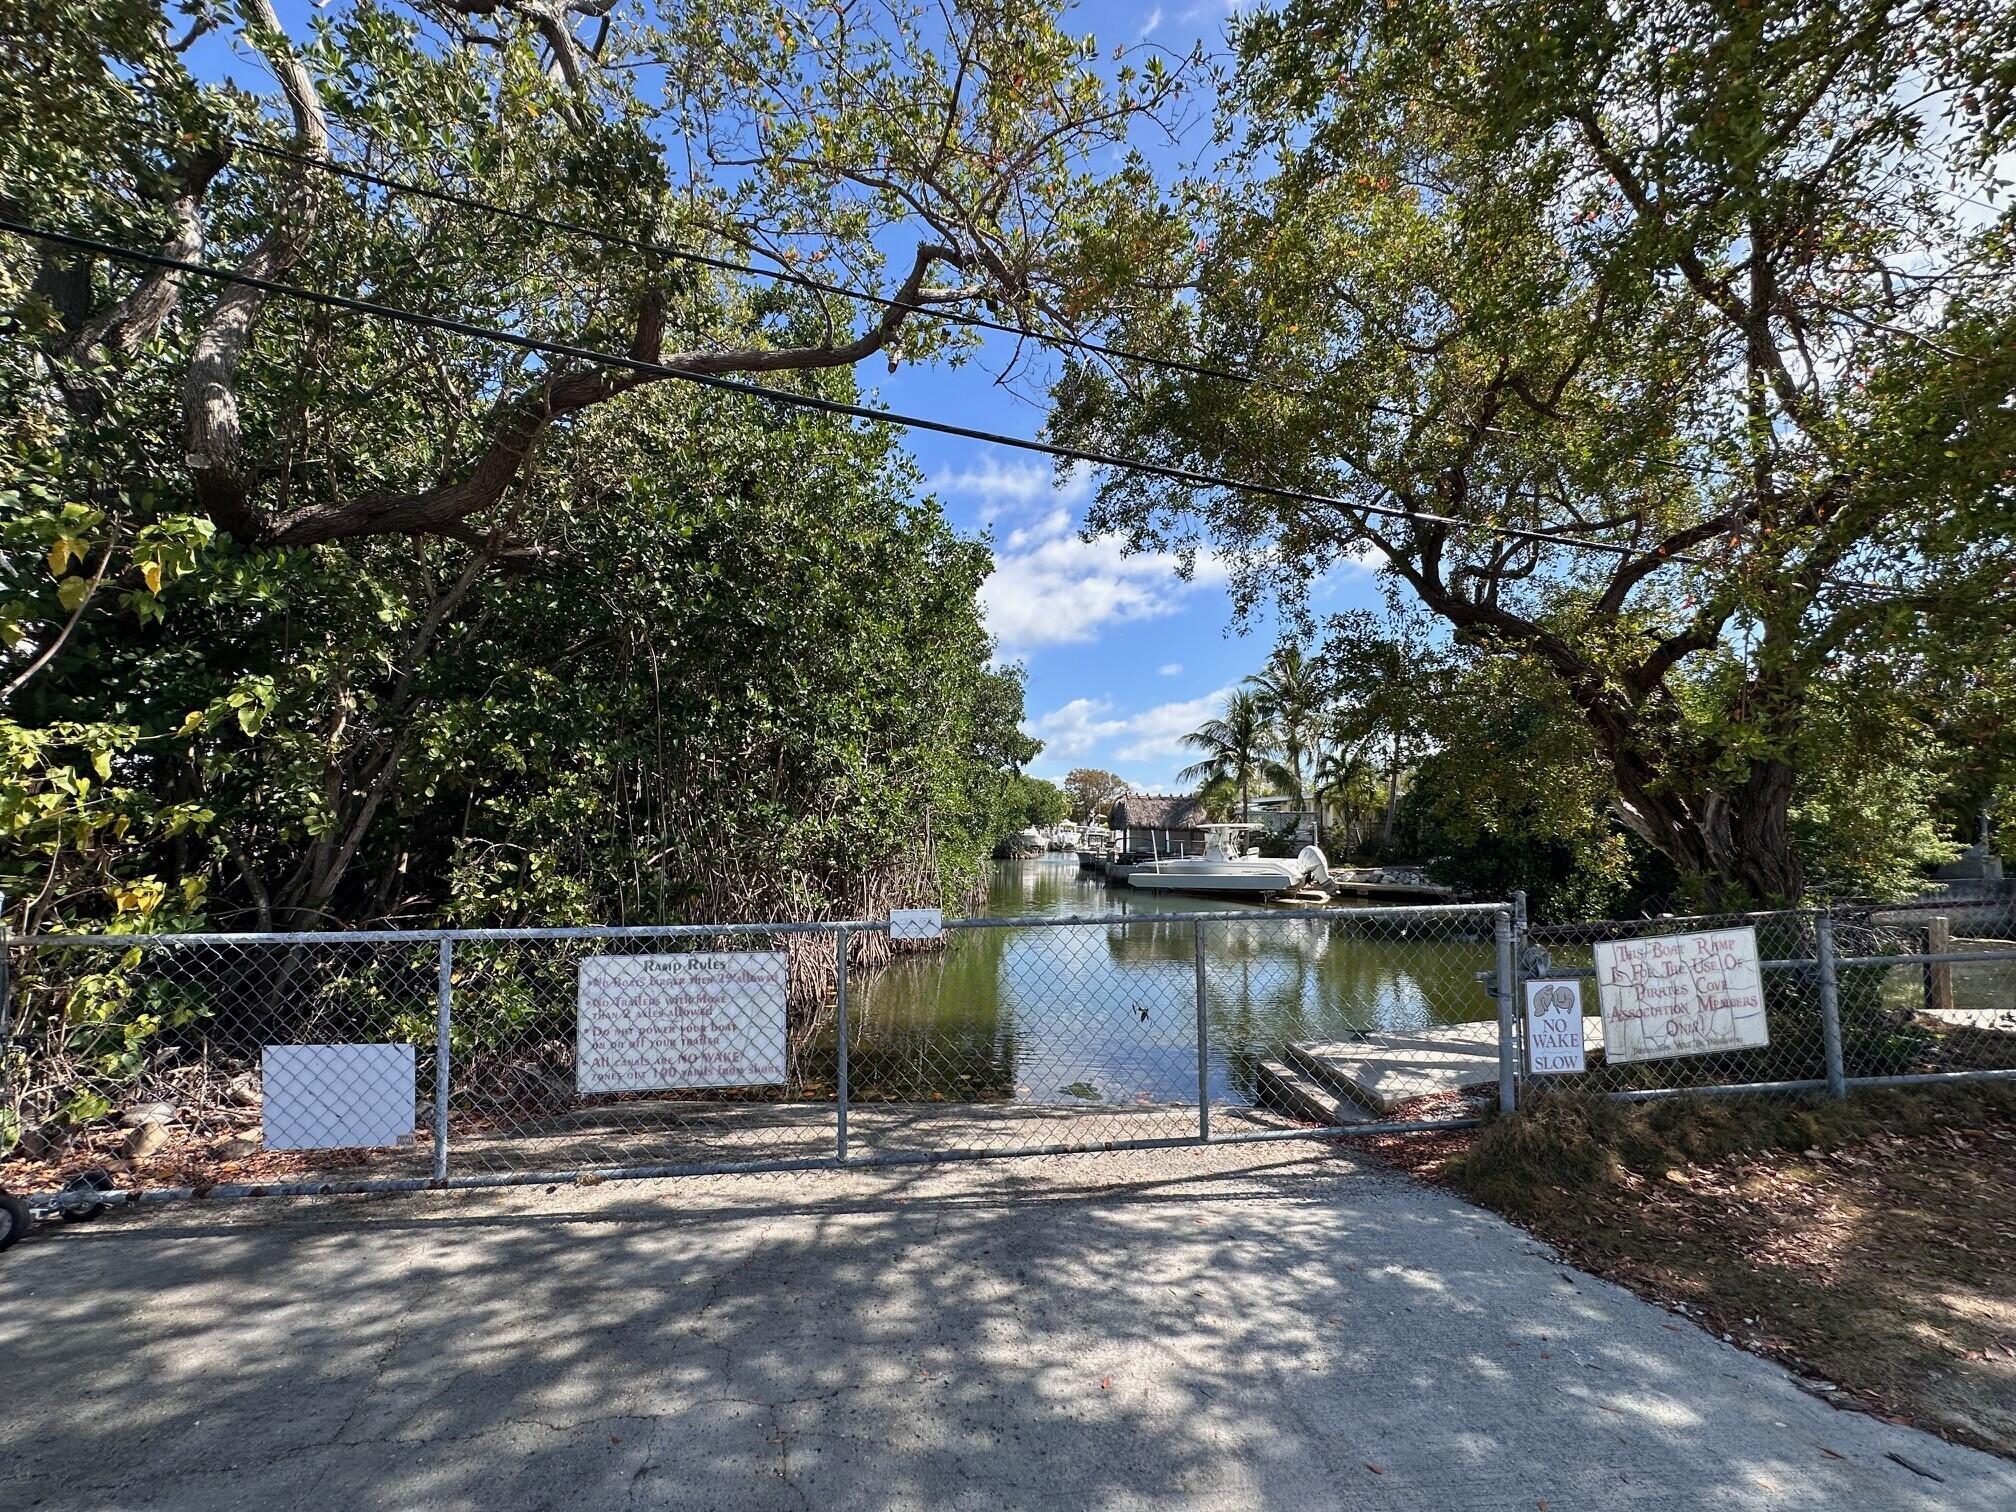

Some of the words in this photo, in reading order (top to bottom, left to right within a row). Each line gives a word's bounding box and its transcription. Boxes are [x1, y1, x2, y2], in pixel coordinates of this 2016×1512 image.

[1543, 1019, 1567, 1033] NO
[1532, 1033, 1580, 1049] WAKE
[677, 1053, 699, 1064] NO
[702, 1051, 741, 1064] WAKE
[1535, 1055, 1578, 1070] SLOW
[652, 1066, 677, 1078] 100
